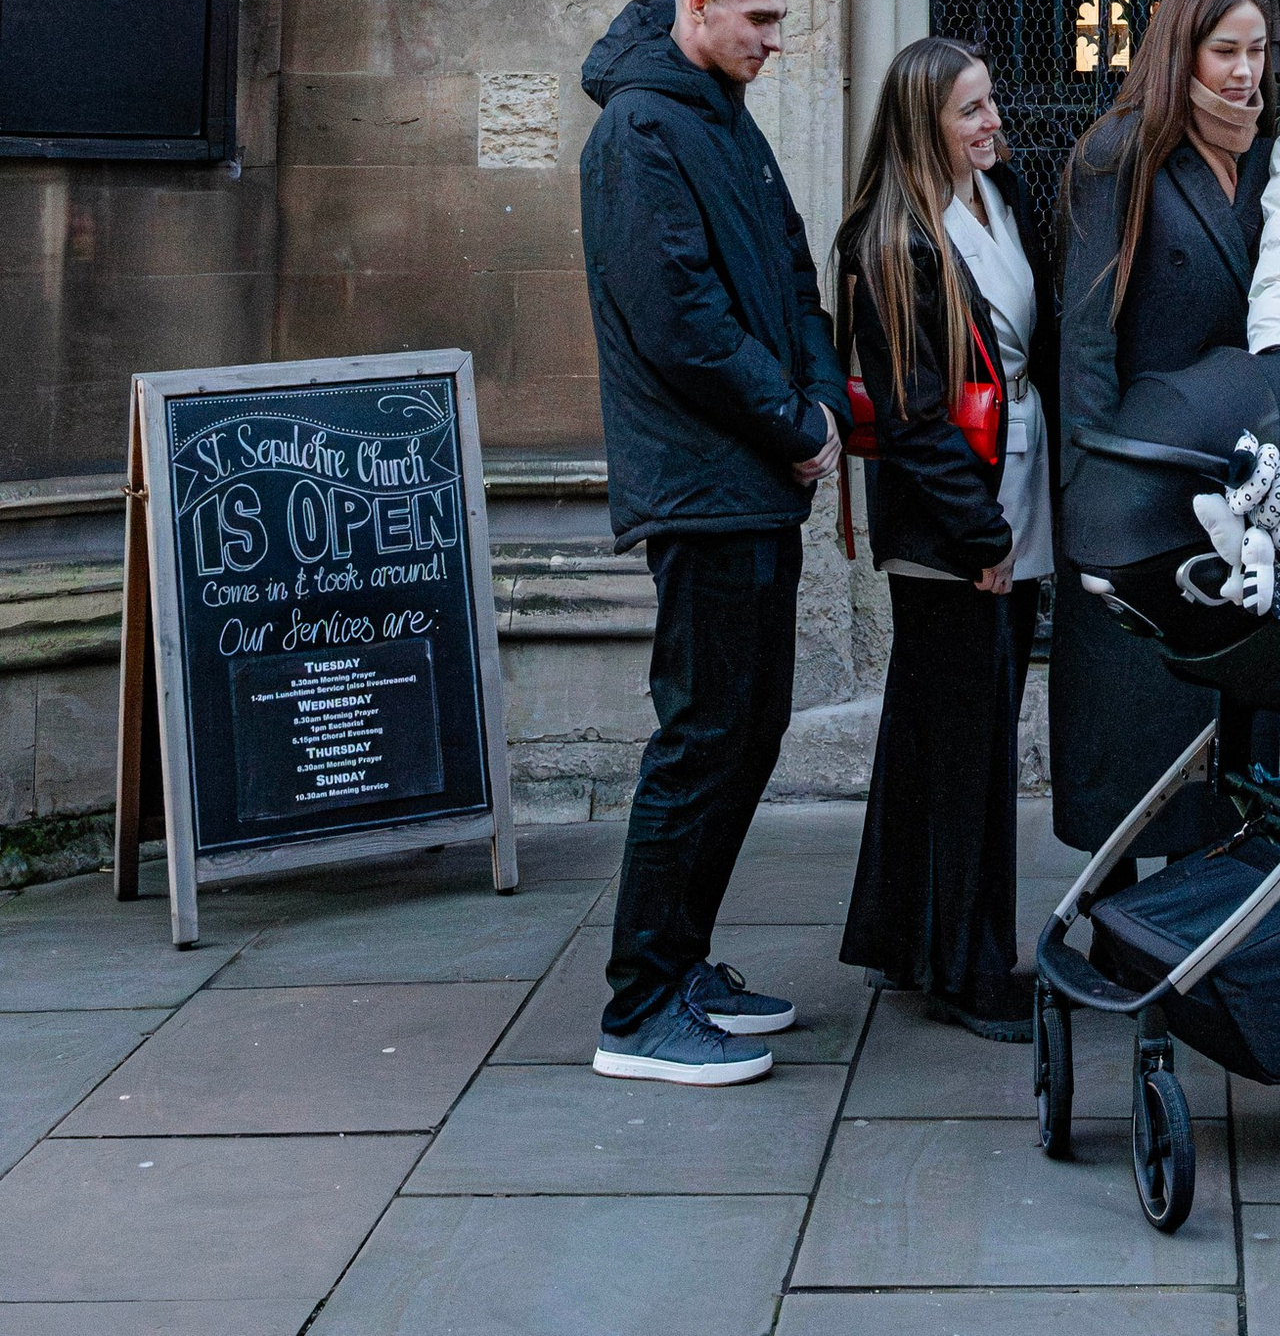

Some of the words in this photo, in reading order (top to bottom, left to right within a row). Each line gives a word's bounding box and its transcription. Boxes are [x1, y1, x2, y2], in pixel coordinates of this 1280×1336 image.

[196, 432, 236, 483] St.
[237, 424, 350, 478] Sepulchre
[357, 437, 431, 487] Church
[193, 483, 269, 576] IS
[287, 479, 459, 564] OPEN
[202, 581, 260, 608] Come
[264, 577, 289, 602] in
[314, 563, 364, 593] look
[370, 552, 448, 587] around!
[219, 617, 274, 656] Our
[282, 608, 376, 652] Services
[382, 609, 440, 639] are:
[304, 658, 361, 674] TUESDAY
[275, 687, 315, 699] Lunchtime
[316, 683, 346, 694] Service
[346, 679, 366, 691] (also
[366, 674, 418, 688] livestreamed)
[320, 673, 351, 685] Morning
[351, 670, 377, 681] Prayer
[297, 693, 373, 713] WEDNESDAY
[322, 711, 354, 722] Morning
[354, 707, 380, 719] Prayer
[321, 730, 347, 741] Choral
[347, 726, 383, 738] Evensong
[305, 741, 372, 760] THURSDAY
[326, 758, 357, 770] Morning
[357, 754, 383, 766] Prayer
[316, 770, 366, 787] SUNDAY
[328, 786, 360, 798] Morning
[360, 781, 390, 793] Service
